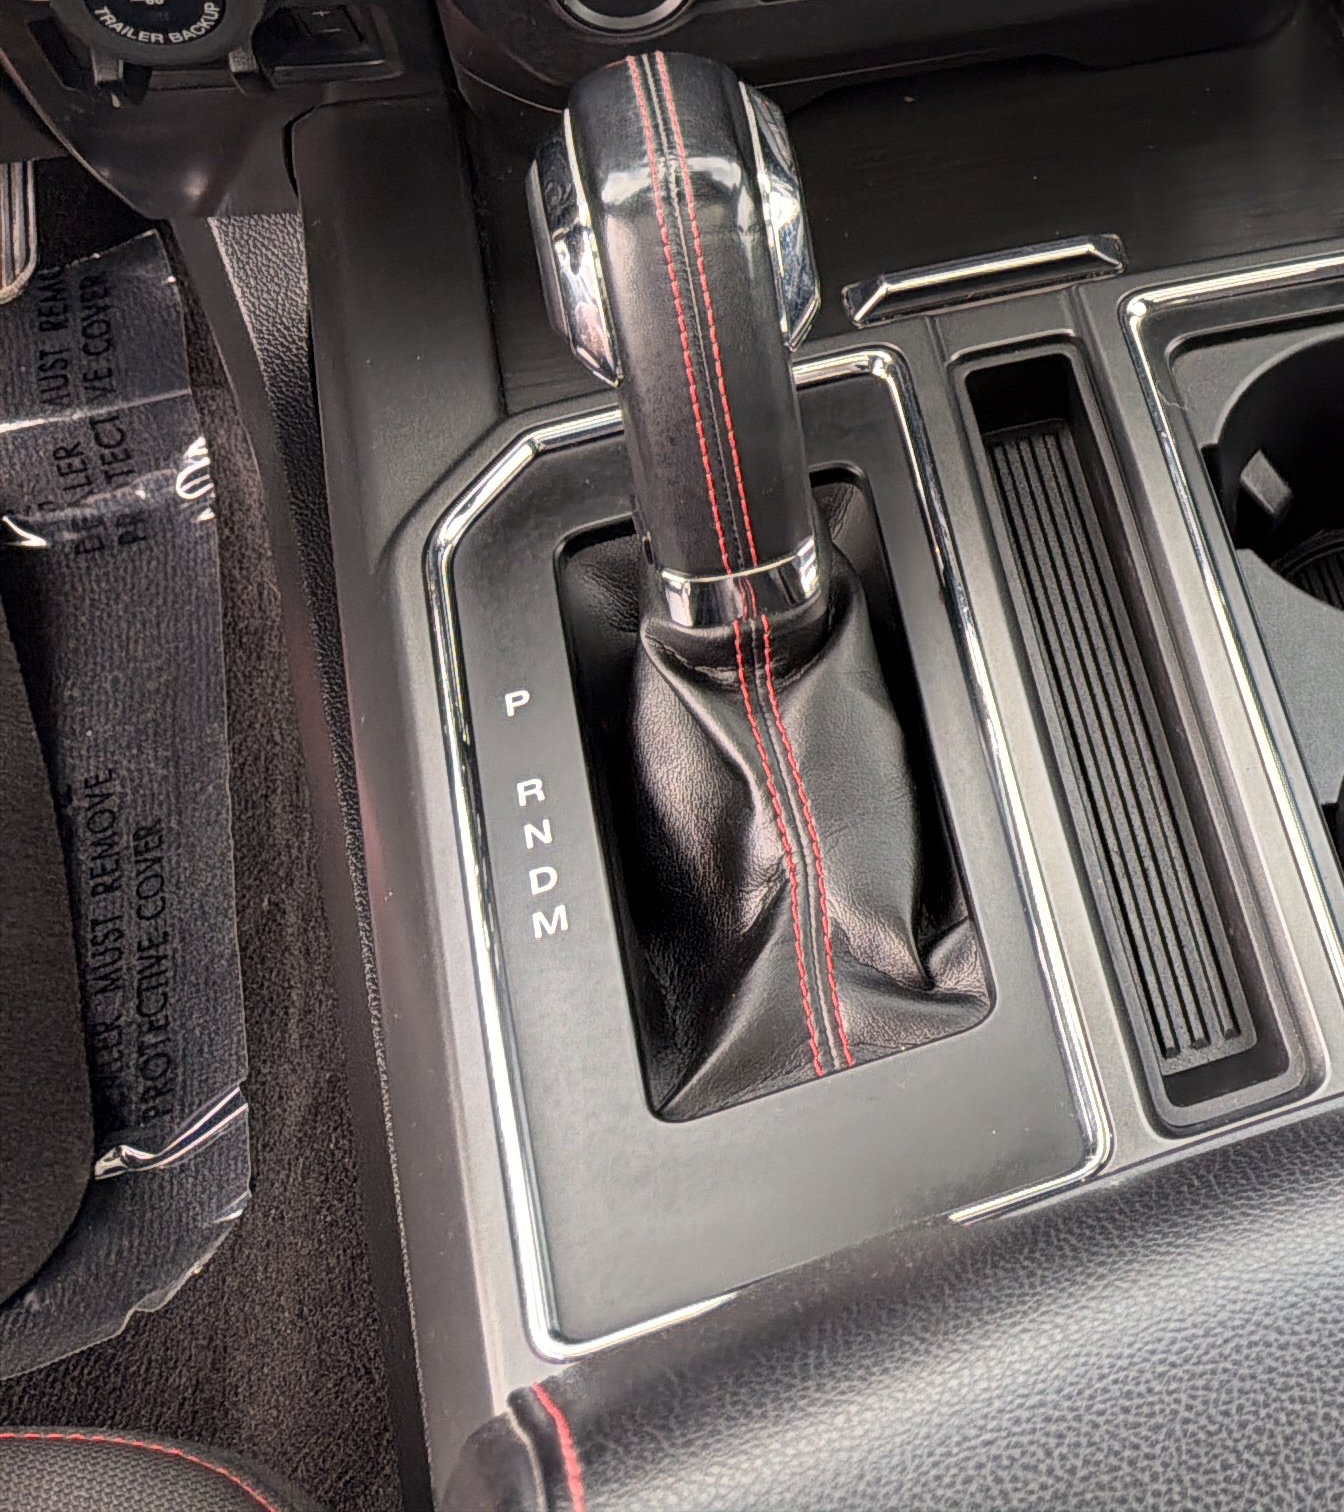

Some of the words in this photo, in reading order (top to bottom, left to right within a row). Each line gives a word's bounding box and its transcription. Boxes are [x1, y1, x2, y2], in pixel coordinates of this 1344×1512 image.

[94, 6, 165, 44] TRAILER
[168, 2, 222, 44] BACKUP
[79, 270, 113, 359] COVER
[504, 690, 530, 718] P
[516, 778, 546, 807] R
[84, 769, 123, 899] REMOVE
[523, 819, 553, 849] N
[132, 818, 167, 921] COVER
[528, 866, 558, 896] D
[532, 904, 568, 939] M
[90, 915, 123, 997] MUST
[135, 930, 174, 1126] PROTECTIVE
